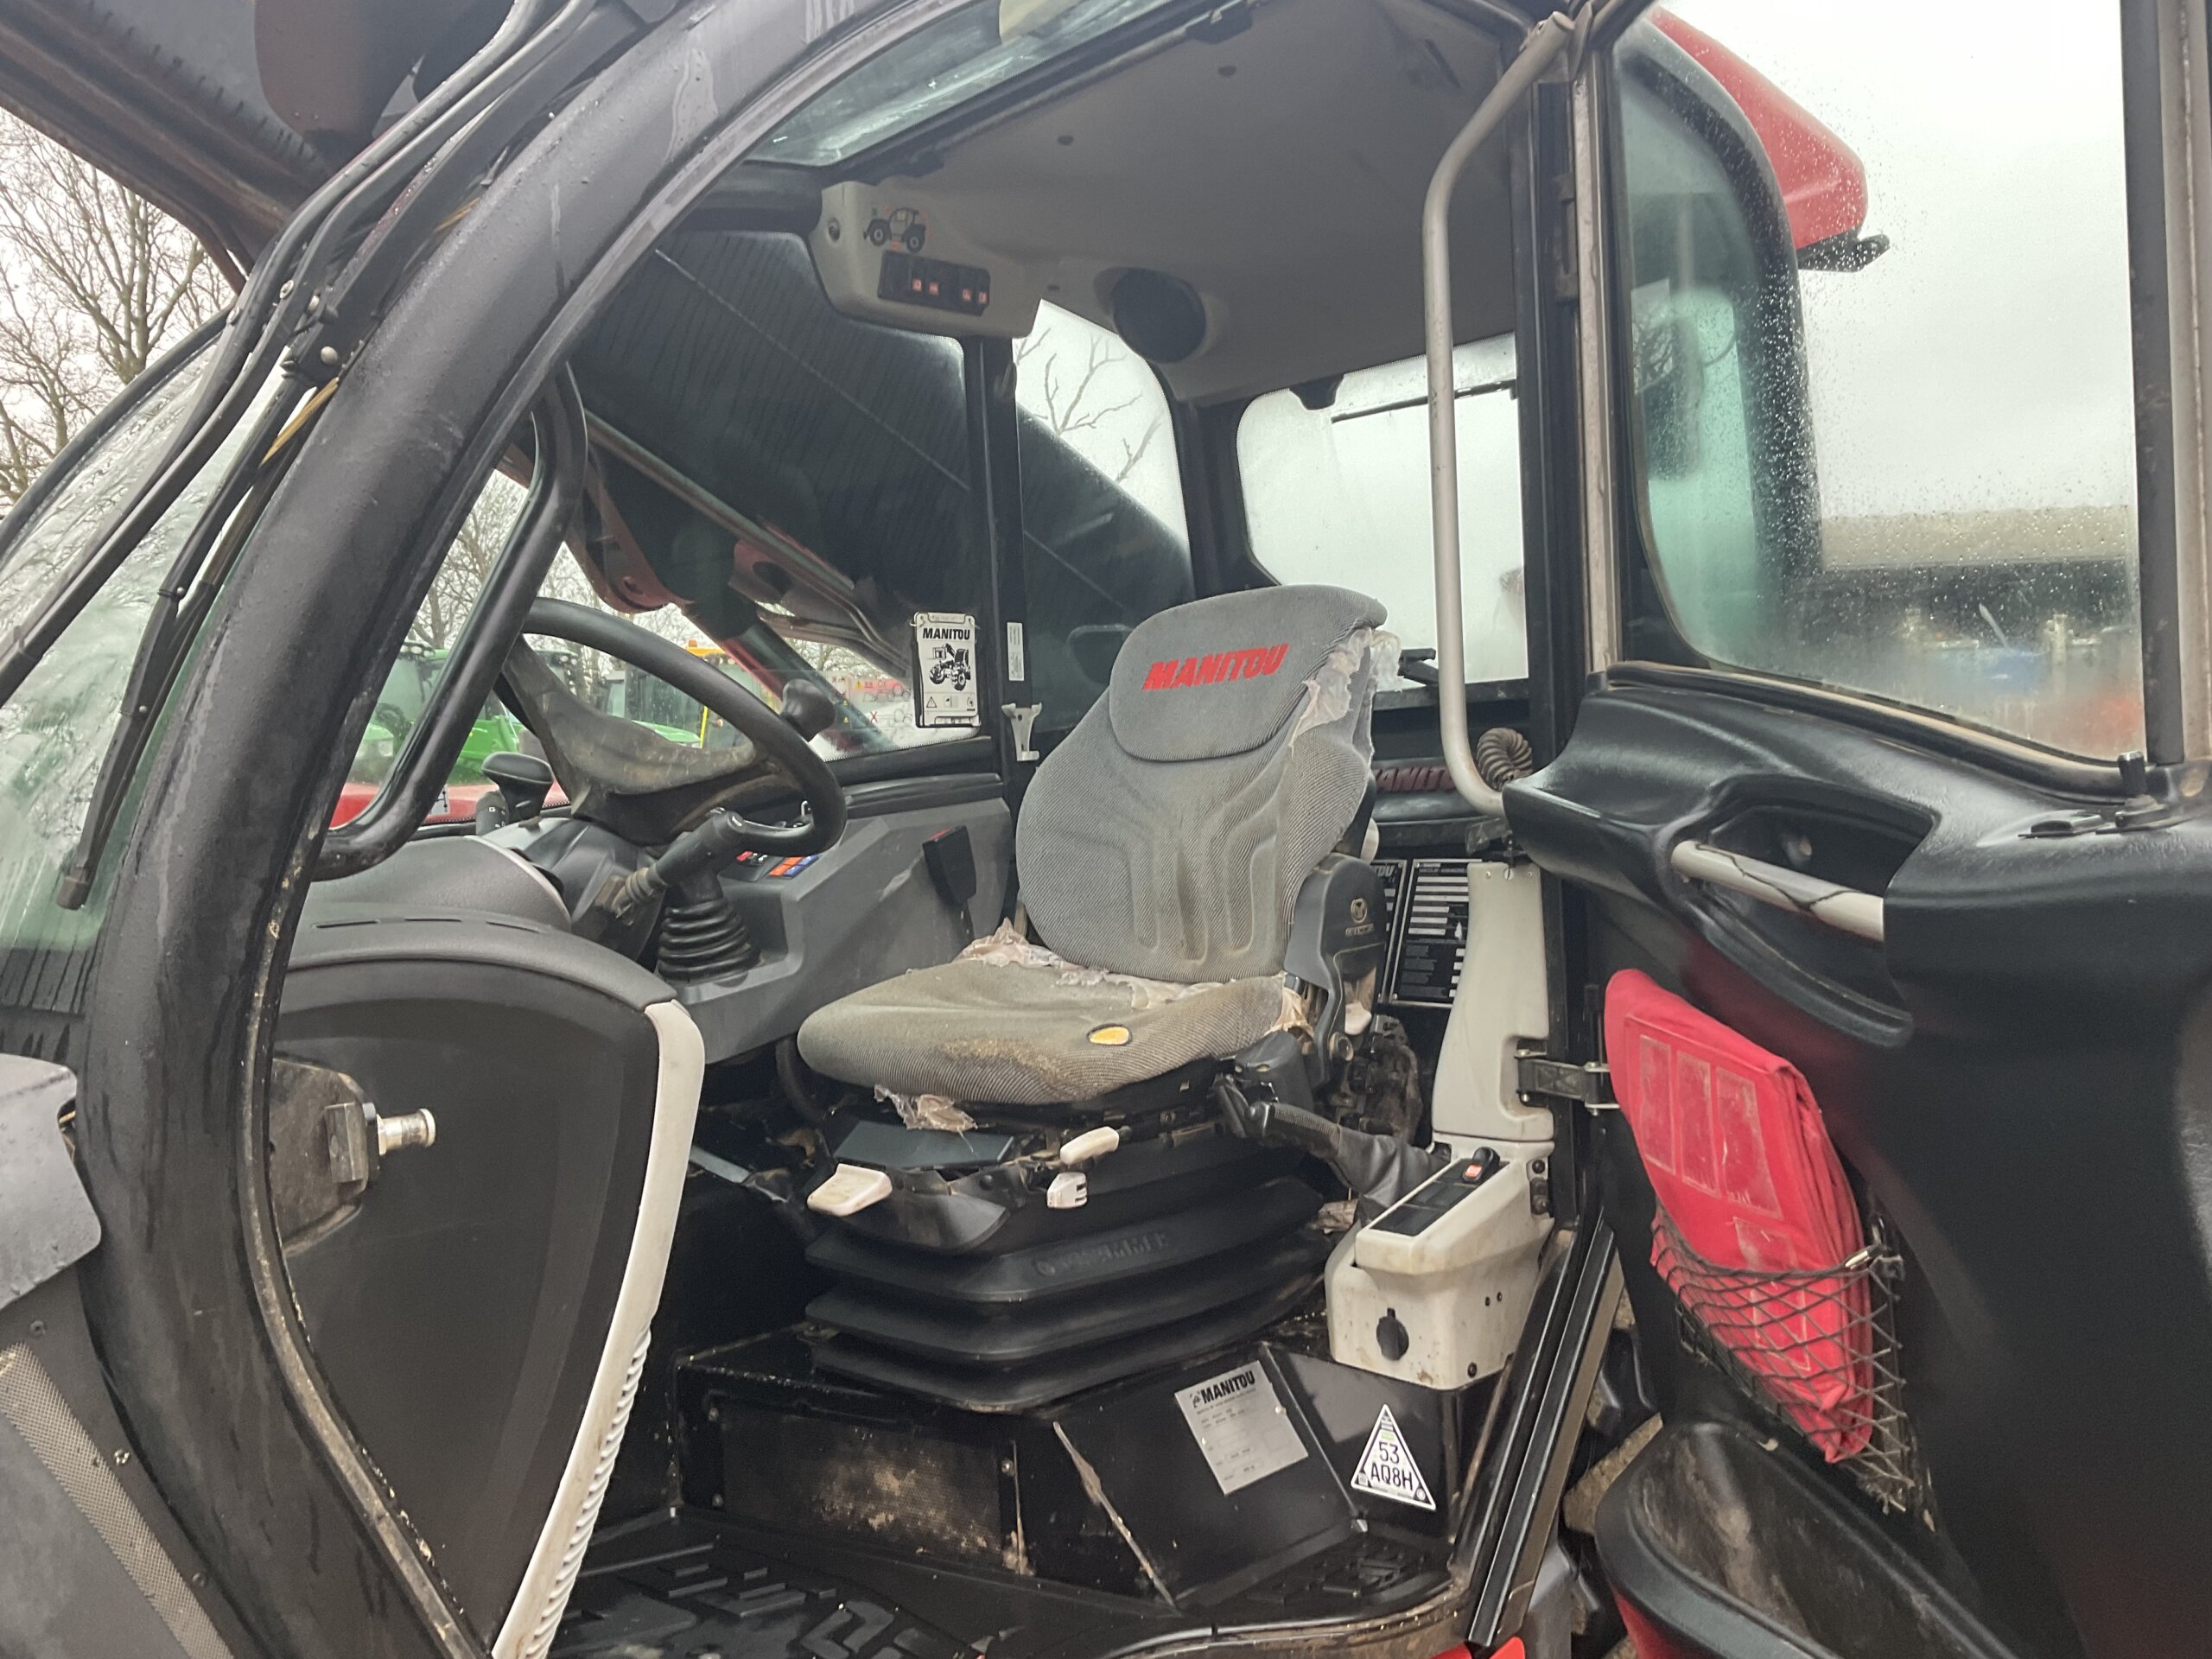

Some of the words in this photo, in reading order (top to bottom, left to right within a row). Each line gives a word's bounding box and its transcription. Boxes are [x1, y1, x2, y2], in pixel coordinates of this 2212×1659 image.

[923, 627, 970, 640] MANITOU
[1142, 643, 1289, 691] MANITOU
[1200, 1370, 1255, 1404] MANITOU
[1378, 1440, 1400, 1465] 53
[1370, 1461, 1413, 1491] AQ8H
